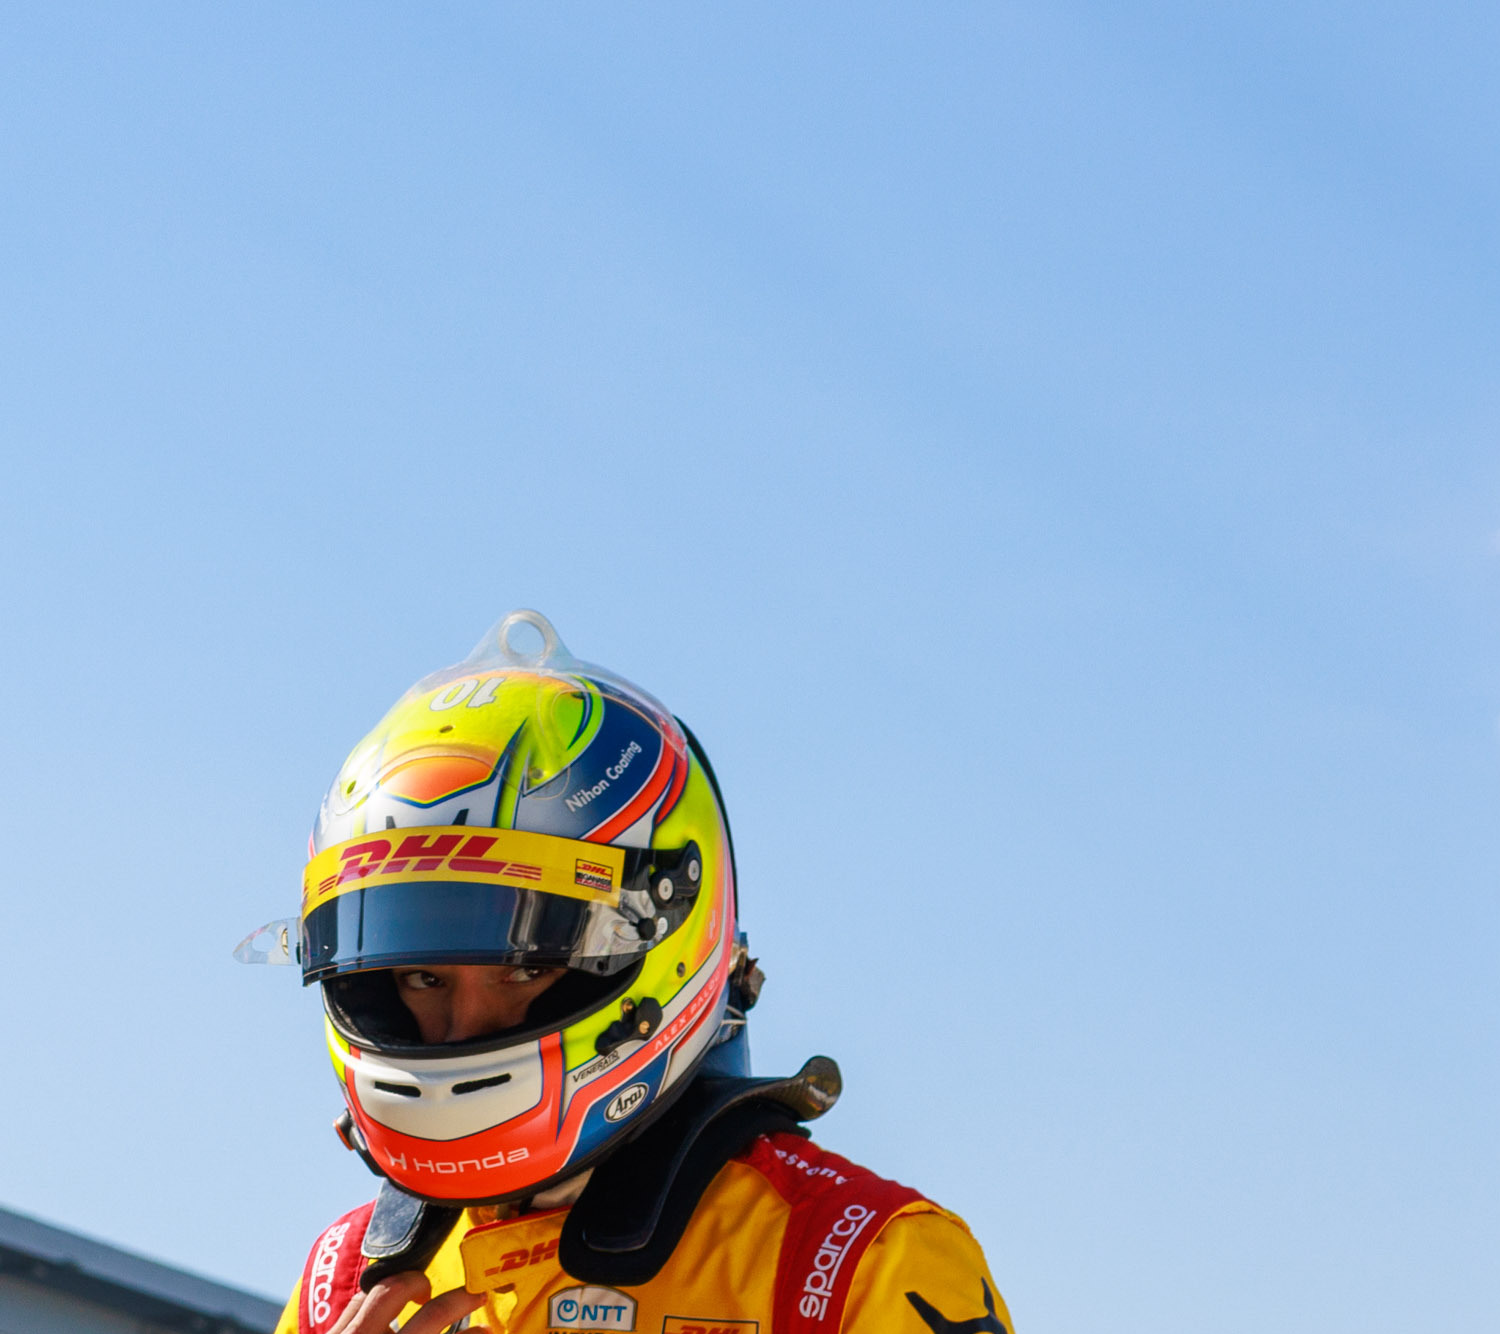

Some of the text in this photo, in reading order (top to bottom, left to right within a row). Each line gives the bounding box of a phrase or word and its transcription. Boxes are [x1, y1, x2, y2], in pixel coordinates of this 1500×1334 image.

[428, 676, 507, 712] 10
[564, 739, 643, 815] Nihon Coating
[335, 834, 507, 887] DHL
[653, 1015, 687, 1052] ALEX
[612, 1087, 644, 1115] Arai
[413, 1146, 530, 1175] Honda
[310, 1221, 352, 1326] sparco
[498, 1236, 562, 1274] DH
[798, 1203, 872, 1321] sparco
[581, 1304, 628, 1323] NTT
